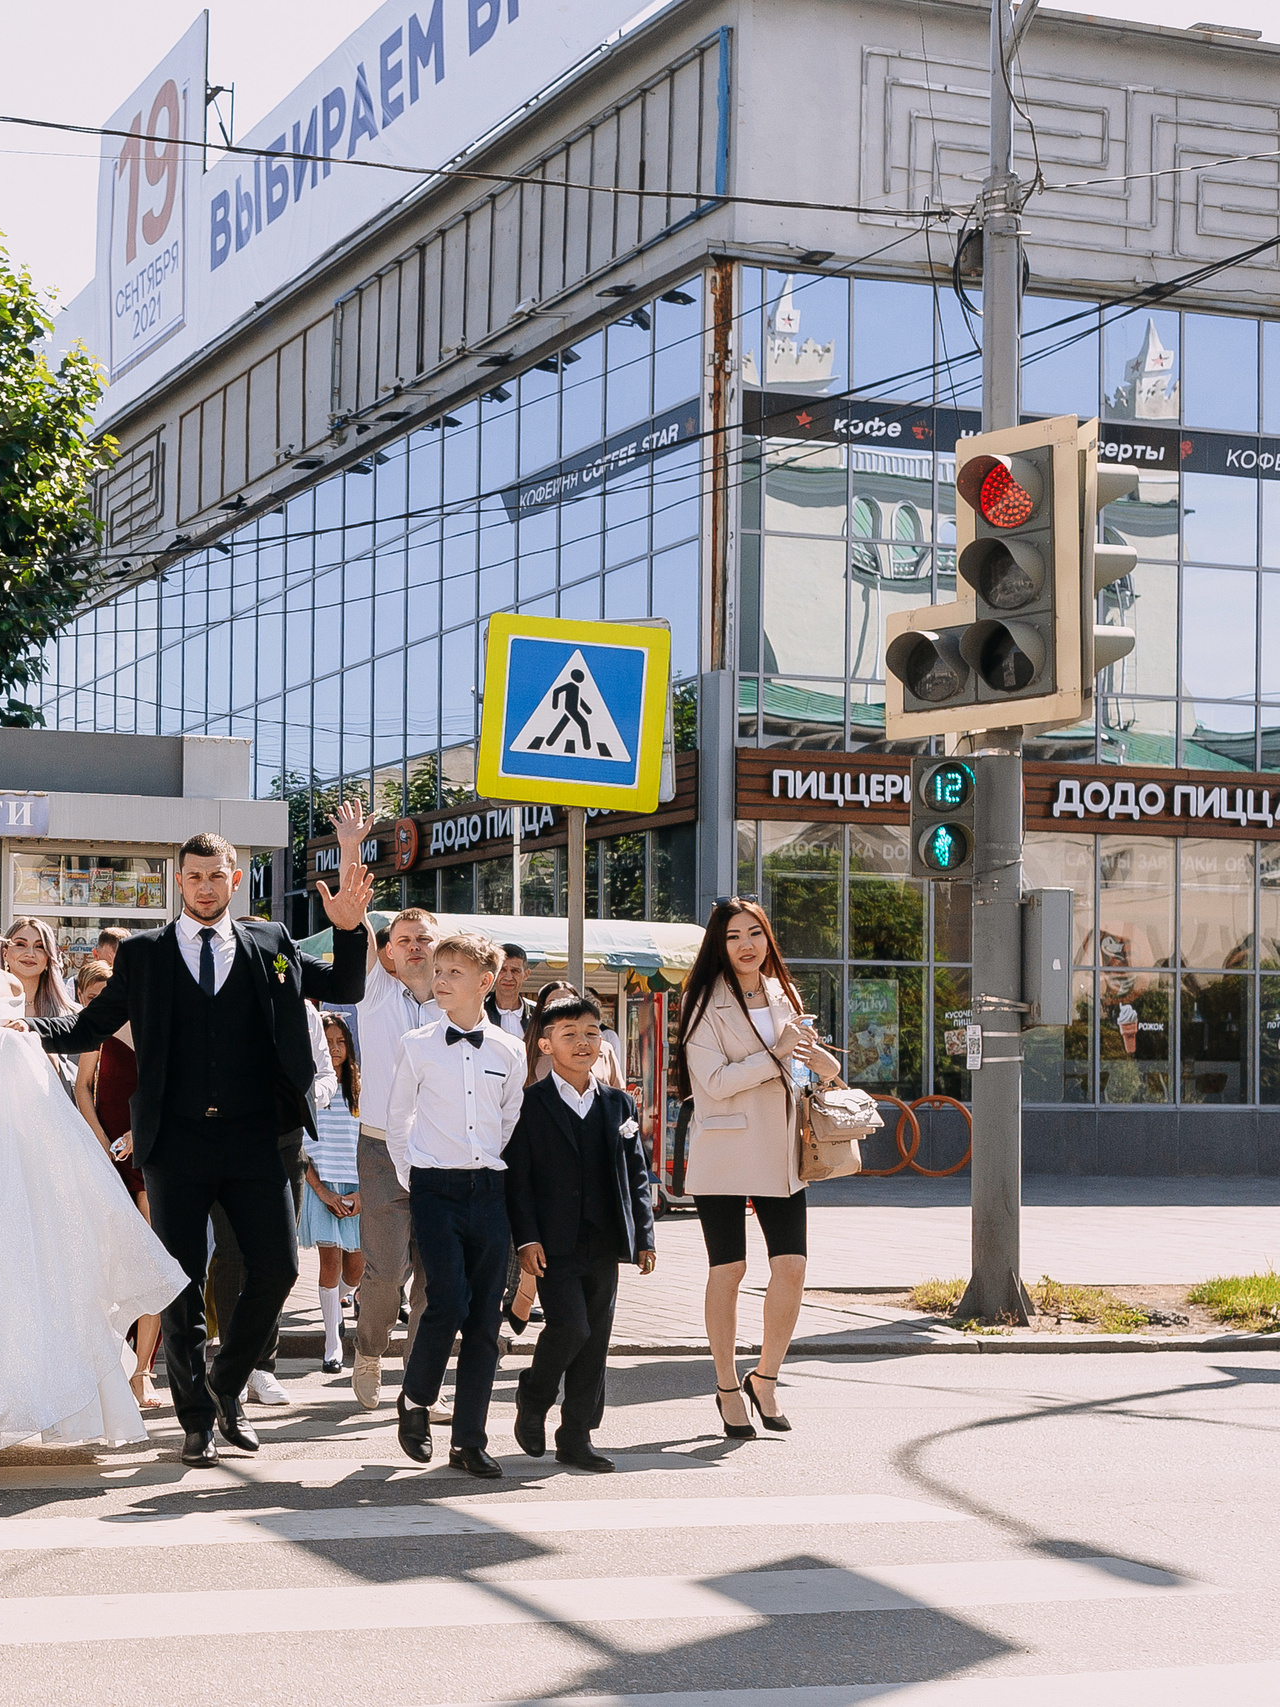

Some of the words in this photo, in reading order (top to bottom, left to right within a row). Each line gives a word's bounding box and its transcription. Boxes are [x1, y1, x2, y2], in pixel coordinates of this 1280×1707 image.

[210, 0, 445, 272] ВЫБИРАЕМ
[119, 79, 180, 266] 19
[115, 241, 180, 318] СЕНТЯБРЯ
[132, 290, 162, 339] 2021
[833, 416, 902, 438] кофе
[519, 470, 579, 511] КОФЕЙНЯ
[582, 442, 637, 483] COFFEE
[641, 423, 679, 453] STAR
[1097, 441, 1166, 462] серты
[772, 769, 911, 808] ПИЦЦЕР
[936, 772, 962, 803] 12
[1053, 779, 1165, 820] ДОДО
[1173, 785, 1280, 829] ПИЦЦ
[430, 814, 482, 856] ДОДО
[780, 840, 875, 860] ДОСТАКА
[945, 1009, 973, 1020] КУСОЧЕ
[1138, 1022, 1165, 1031] РОЖОК
